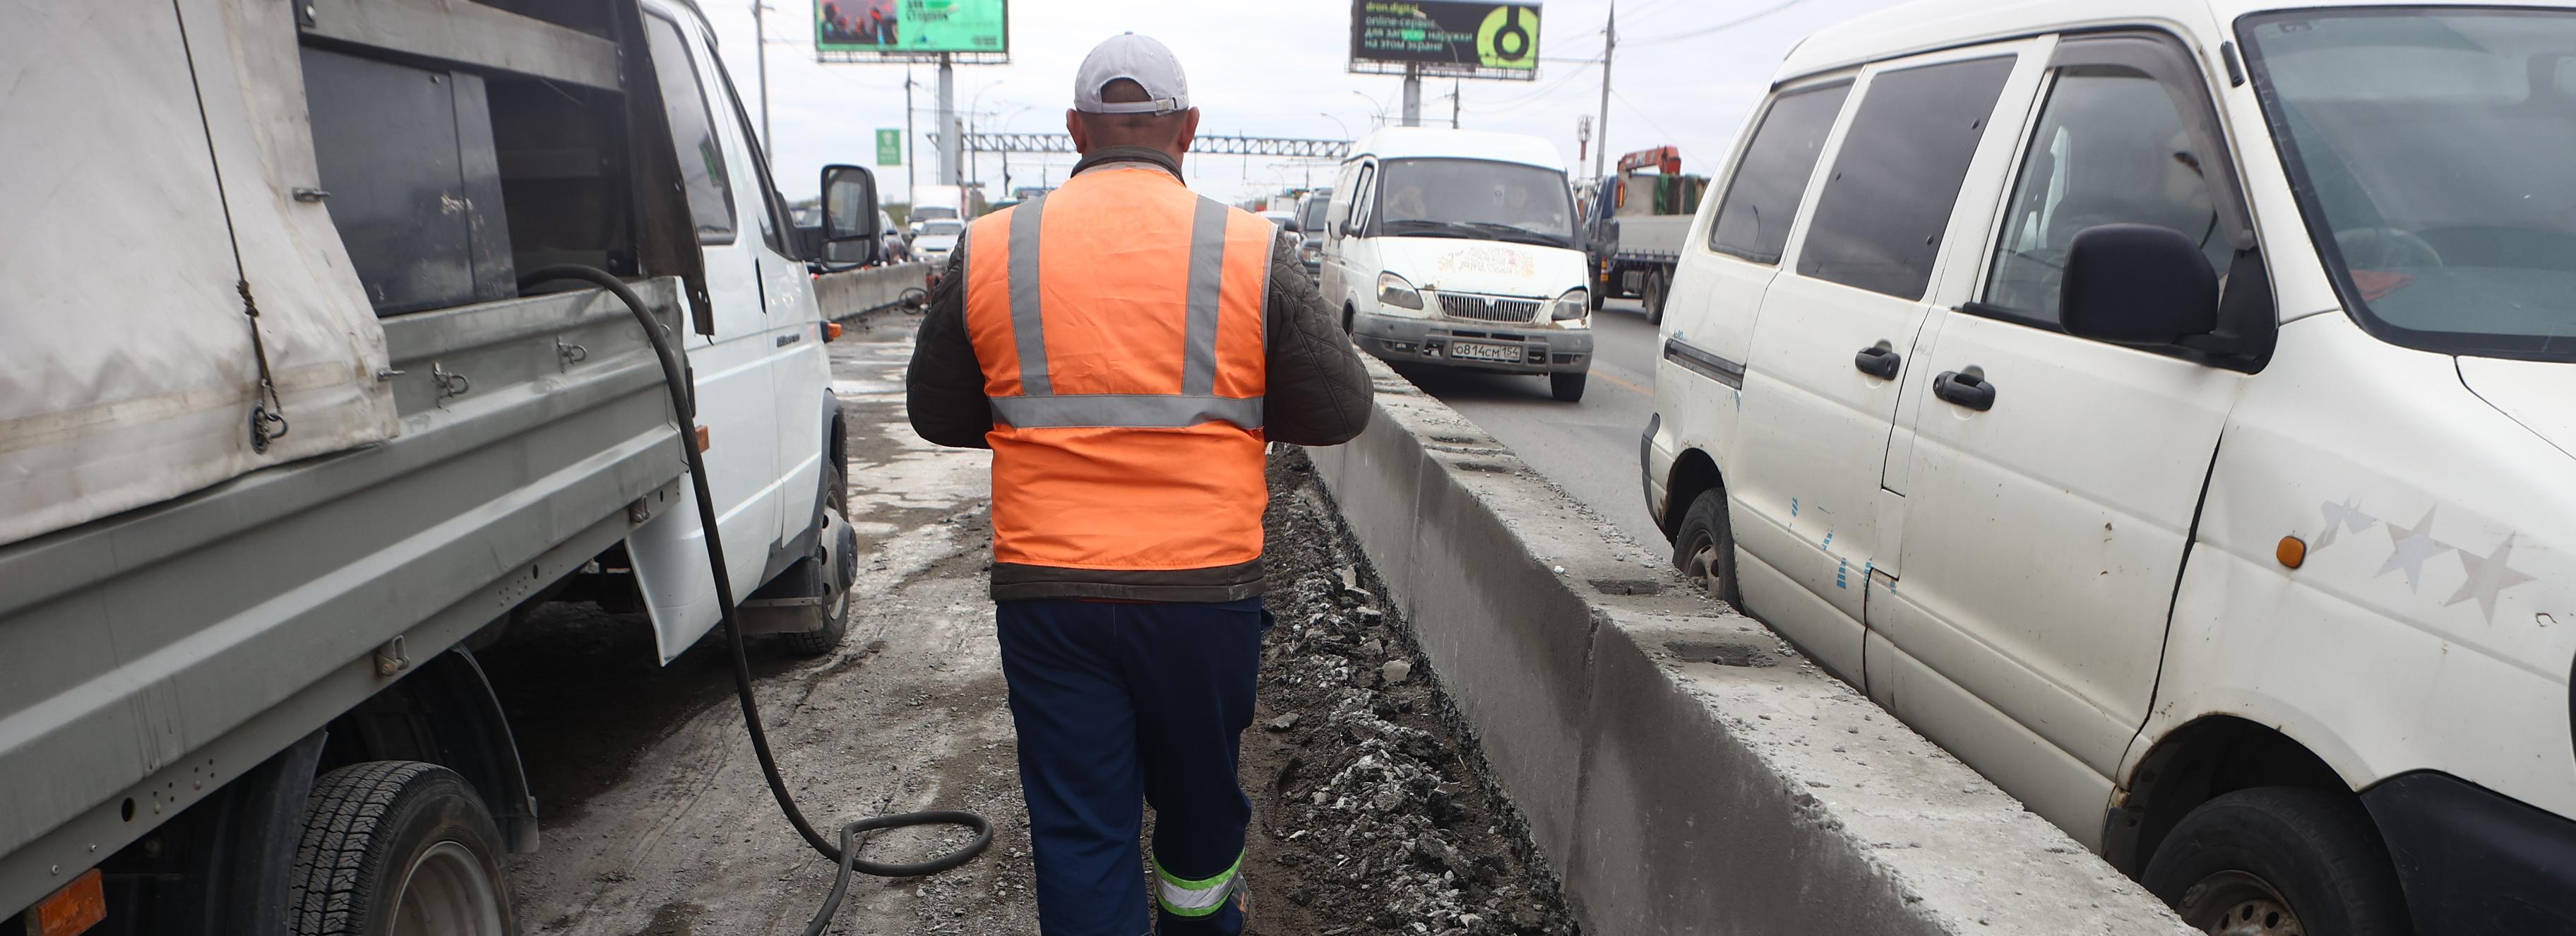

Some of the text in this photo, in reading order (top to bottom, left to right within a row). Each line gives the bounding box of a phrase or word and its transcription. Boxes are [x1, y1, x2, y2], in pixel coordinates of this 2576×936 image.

[1365, 28, 1384, 40] для
[1365, 40, 1443, 52] на этом экране
[1502, 347, 1518, 356] 154
